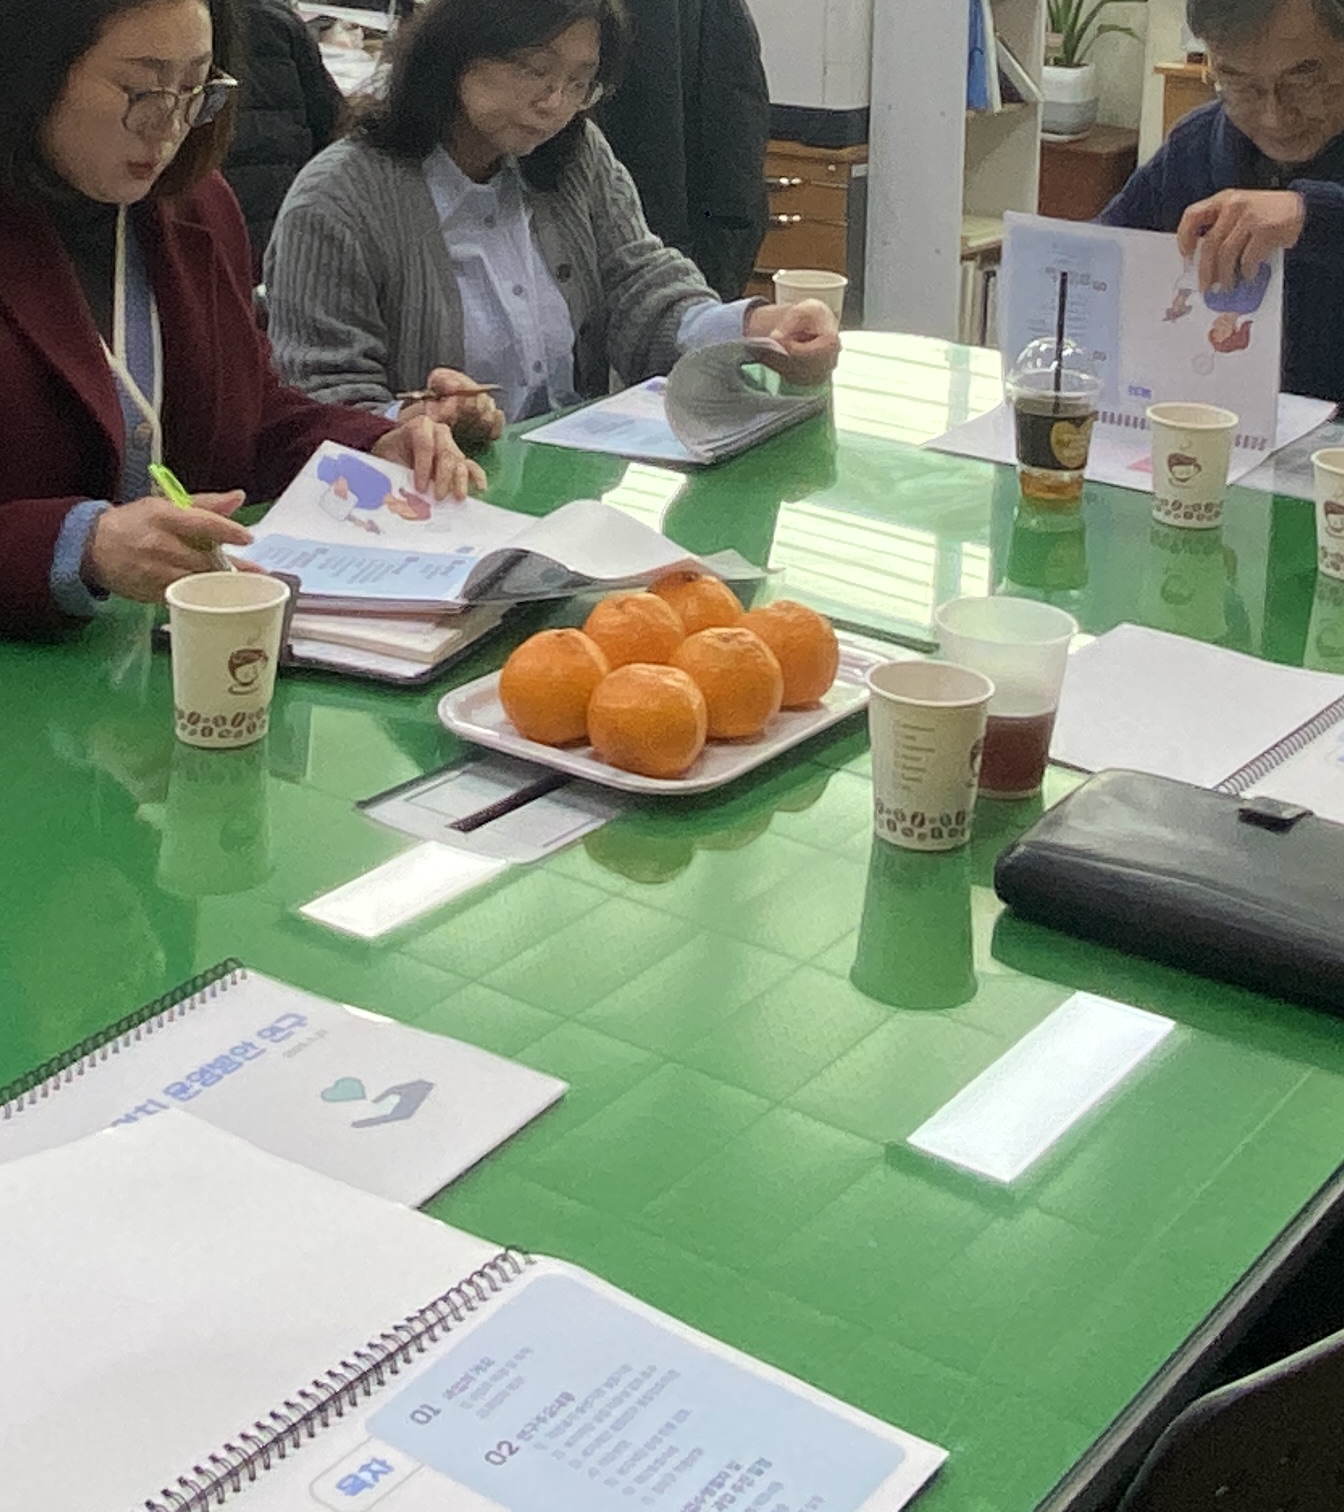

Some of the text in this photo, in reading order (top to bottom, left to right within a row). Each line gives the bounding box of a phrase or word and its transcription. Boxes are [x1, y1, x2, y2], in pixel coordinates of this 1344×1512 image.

[163, 1040, 268, 1103] 운영방안
[256, 1012, 308, 1043] 연구
[408, 1403, 442, 1425] 01
[484, 1440, 521, 1466] 02
[335, 1456, 395, 1497] 목차
